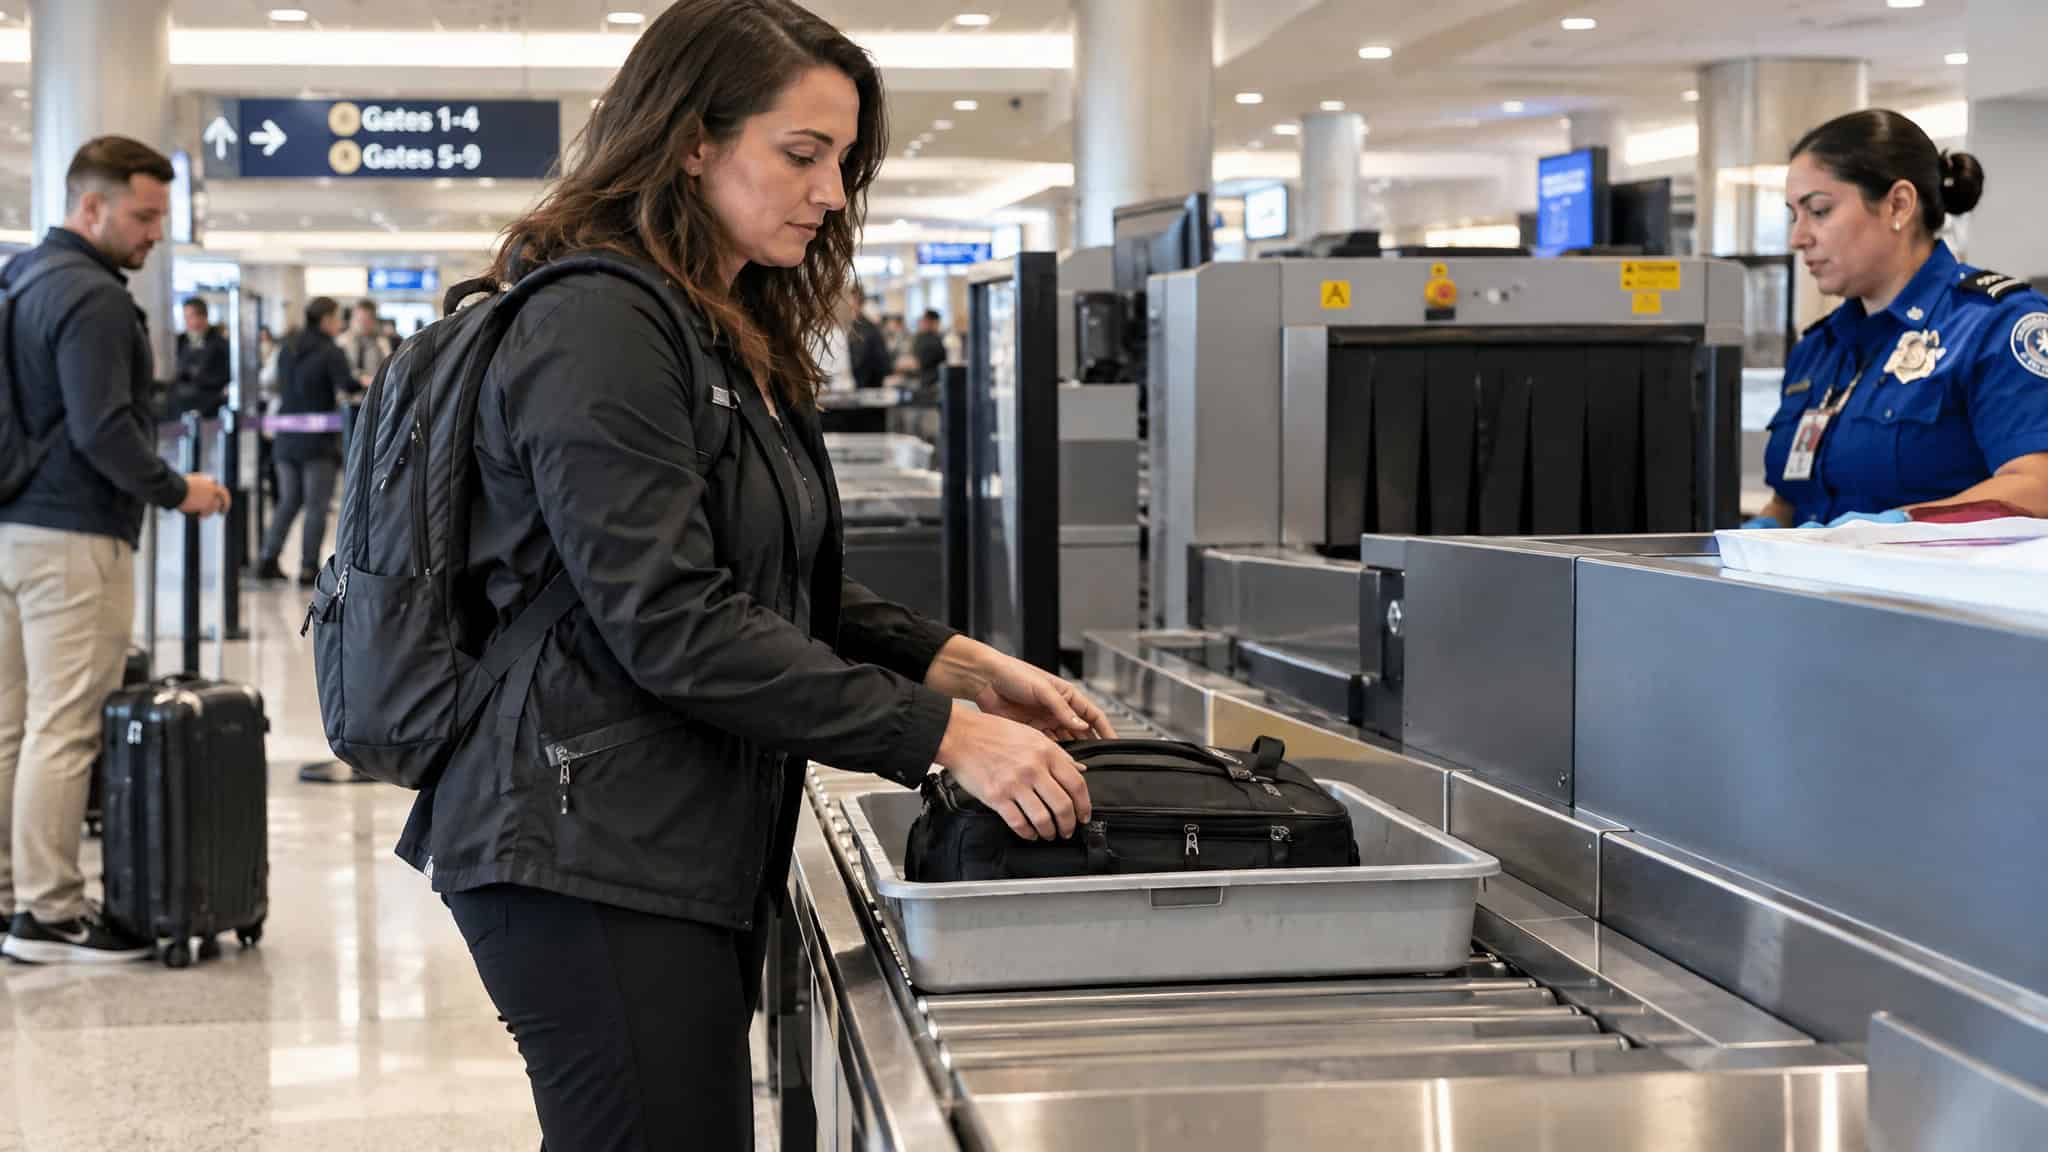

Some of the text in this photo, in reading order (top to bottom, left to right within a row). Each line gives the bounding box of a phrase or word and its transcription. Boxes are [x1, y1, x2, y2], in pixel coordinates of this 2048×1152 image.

[362, 106, 433, 132] Gates
[437, 106, 480, 132] 1-4
[362, 143, 434, 169] Gates
[437, 143, 481, 170] 5-9
